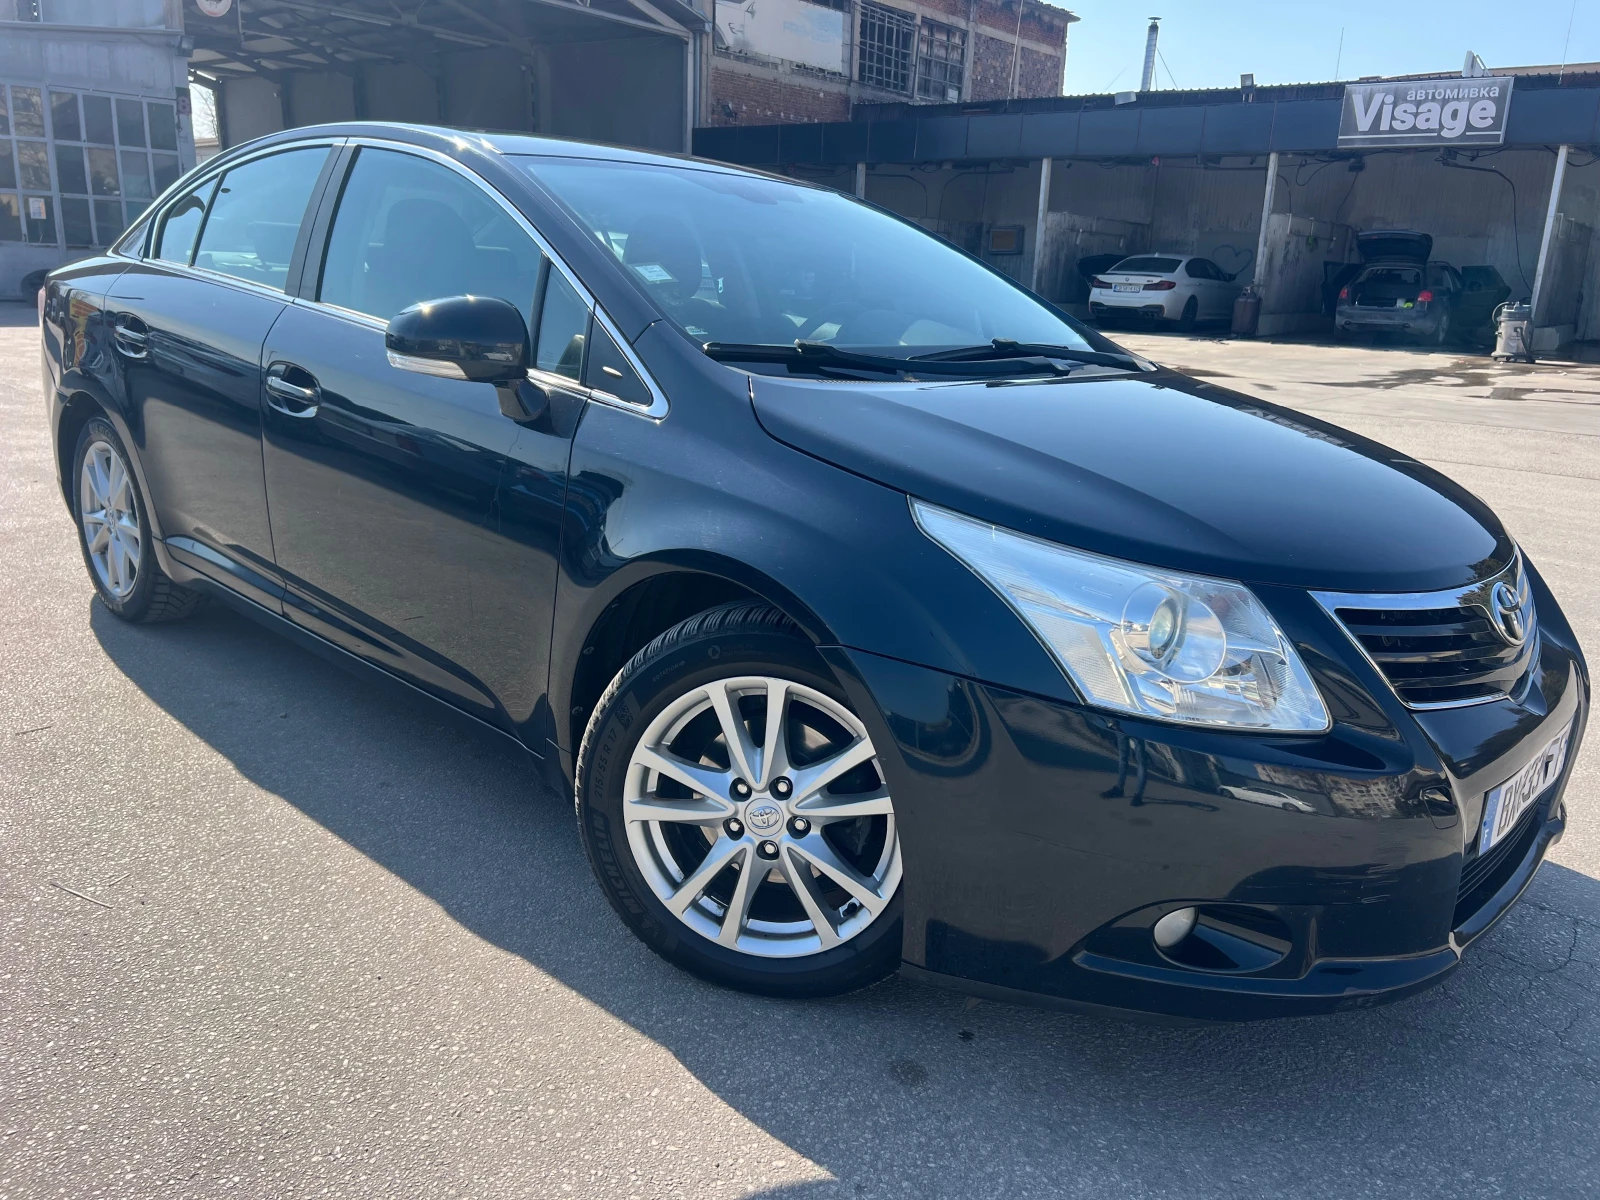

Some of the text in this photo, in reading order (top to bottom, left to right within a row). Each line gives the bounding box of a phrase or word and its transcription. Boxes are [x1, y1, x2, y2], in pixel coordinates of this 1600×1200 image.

[1352, 92, 1497, 138] Visage
[1406, 86, 1500, 101] автомивка
[594, 728, 618, 798] 215/55 R 17
[592, 812, 644, 915] MICHELIN
